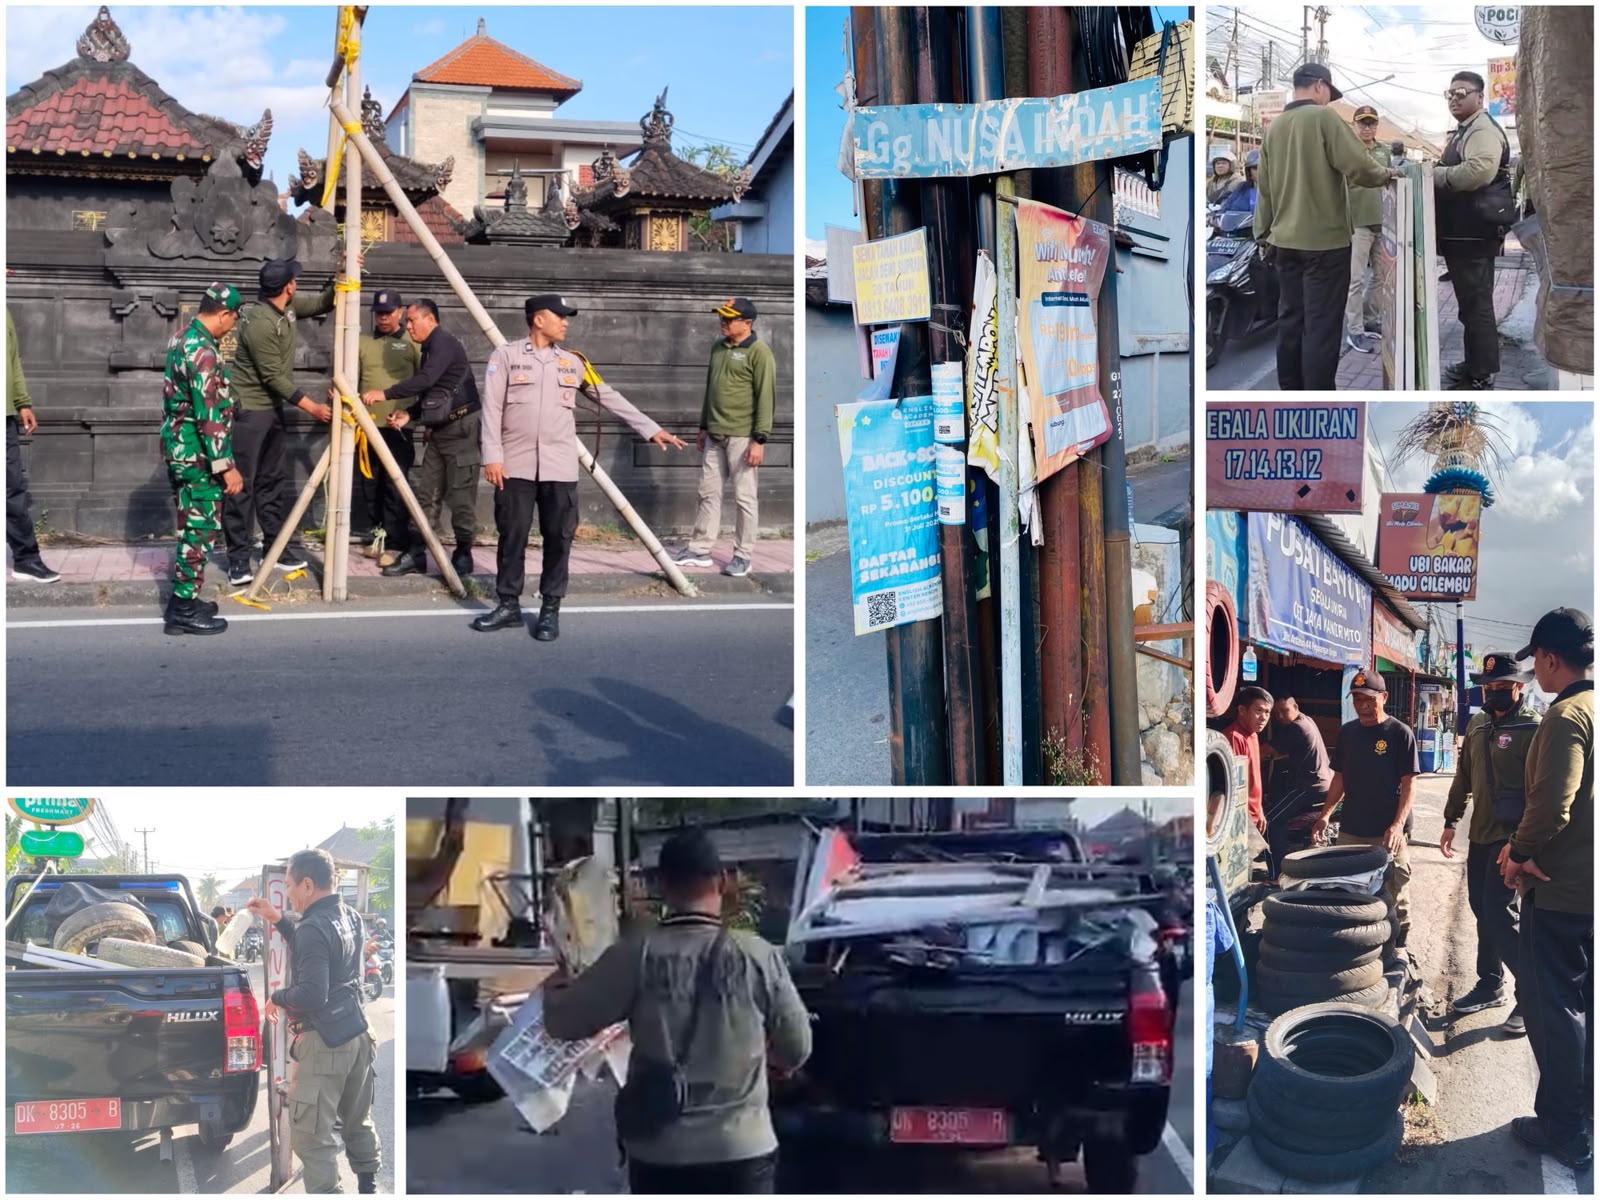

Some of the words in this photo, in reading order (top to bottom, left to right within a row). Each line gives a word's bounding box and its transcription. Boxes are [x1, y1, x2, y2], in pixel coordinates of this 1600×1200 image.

[1487, 9, 1518, 21] POCI
[927, 112, 1026, 162] NUSA
[1034, 94, 1148, 154] INDAH
[1035, 241, 1058, 262] Wifi
[903, 405, 933, 413] ENGLIS
[904, 412, 933, 420] ACADEM
[1274, 407, 1358, 440] UKURAN
[862, 450, 908, 472] BACK
[1225, 449, 1322, 480] 17.14.13.12
[873, 470, 937, 490] DISCOUNT
[861, 504, 877, 516] RP
[881, 486, 938, 511] 5.100.
[859, 547, 916, 570] DAFTAR
[860, 552, 941, 584] SEKARANG!
[1409, 555, 1431, 573] UBI
[1433, 556, 1472, 574] BAKAR
[1420, 575, 1472, 593] CILEMBU
[32, 807, 73, 815] FRESHMART
[167, 1011, 219, 1023] HILUX
[17, 1104, 35, 1123] DK
[49, 1102, 87, 1121] 8305
[108, 1100, 118, 1118] B
